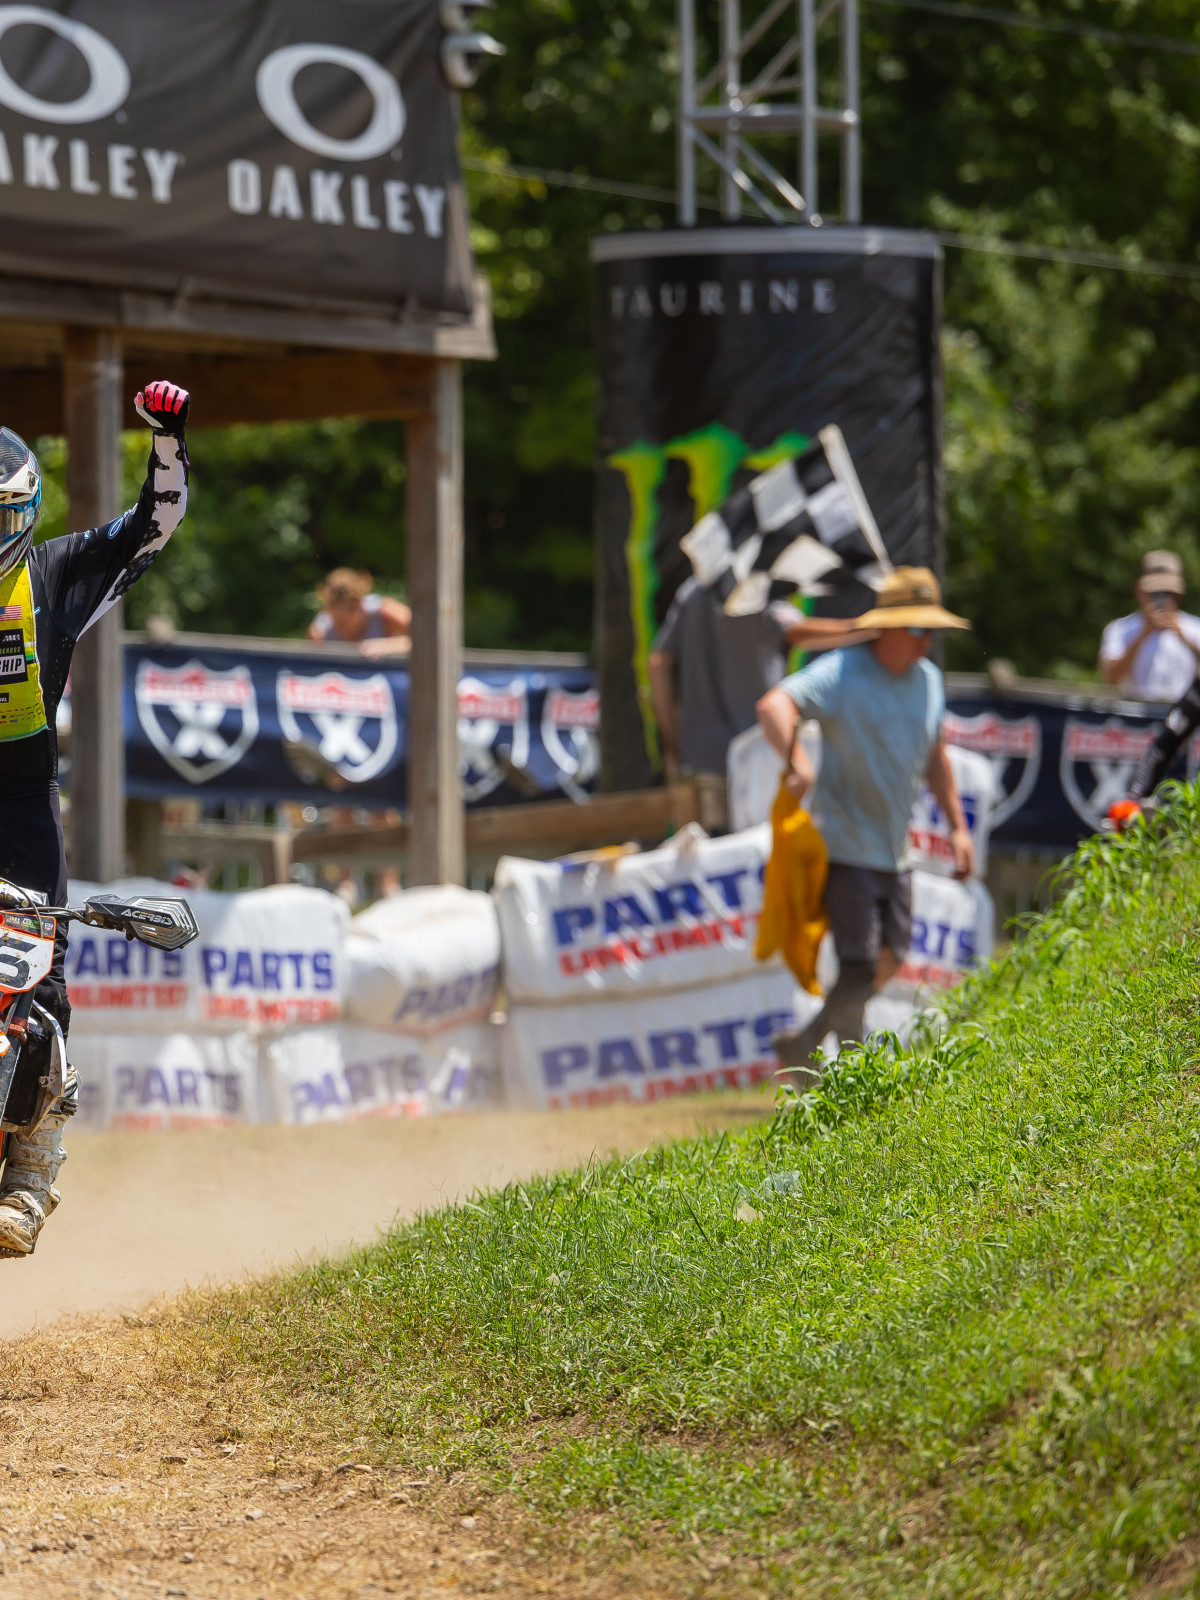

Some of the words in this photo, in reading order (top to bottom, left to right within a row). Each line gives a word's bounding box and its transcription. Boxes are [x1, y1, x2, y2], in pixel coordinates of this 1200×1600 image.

[227, 159, 448, 239] OAKLEY
[609, 279, 837, 319] TAURINE
[66, 937, 185, 978] ARTS
[202, 947, 334, 991] PARTS
